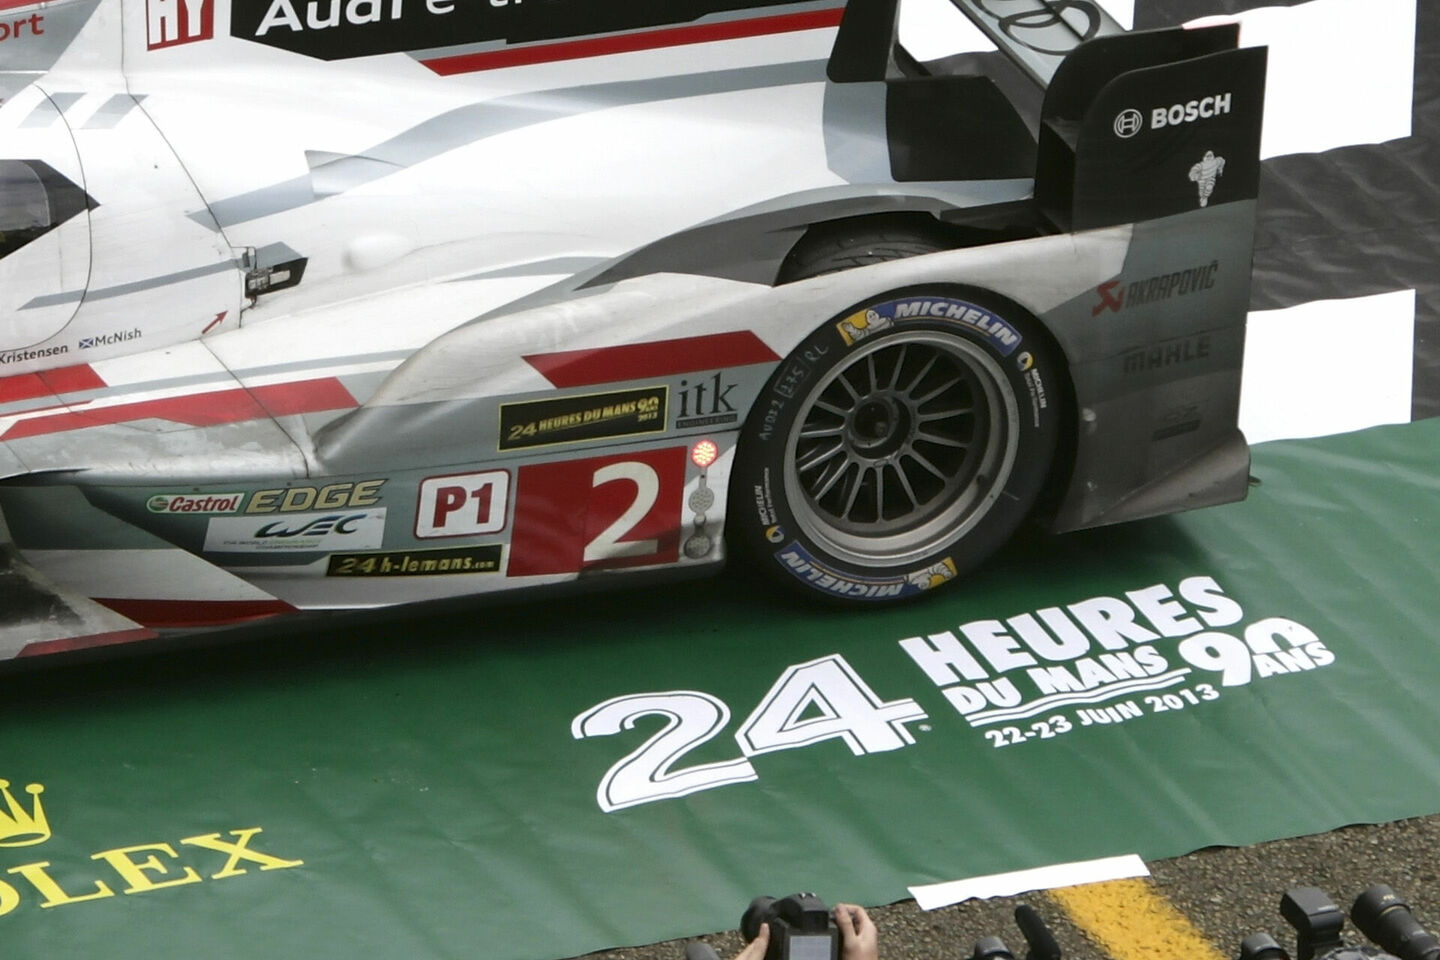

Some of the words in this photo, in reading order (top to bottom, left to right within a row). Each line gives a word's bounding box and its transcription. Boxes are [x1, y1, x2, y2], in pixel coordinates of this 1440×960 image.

[1151, 92, 1232, 131] BOSCH
[94, 328, 142, 348] McNish
[894, 300, 1017, 346] MICHELIN
[1122, 341, 1210, 374] MAHLE
[677, 371, 740, 419] itk
[508, 424, 538, 442] 24
[539, 411, 582, 431] HEURES
[582, 407, 602, 423] DU
[602, 400, 637, 418] MANS
[169, 495, 240, 512] Castrol
[244, 478, 389, 514] EDGE
[432, 482, 493, 528] P1
[582, 460, 661, 562] 2
[253, 514, 368, 538] WEC
[779, 550, 905, 597] MICHELIN
[899, 576, 1244, 687] HEURES
[941, 677, 1023, 716] DU
[1026, 645, 1169, 696] MANS
[1178, 617, 1321, 688] 90
[1251, 641, 1337, 679] ANS
[572, 653, 929, 815] 24
[984, 714, 1074, 749] 22-23
[1075, 700, 1145, 726] JUIN
[1144, 683, 1221, 714] 2013
